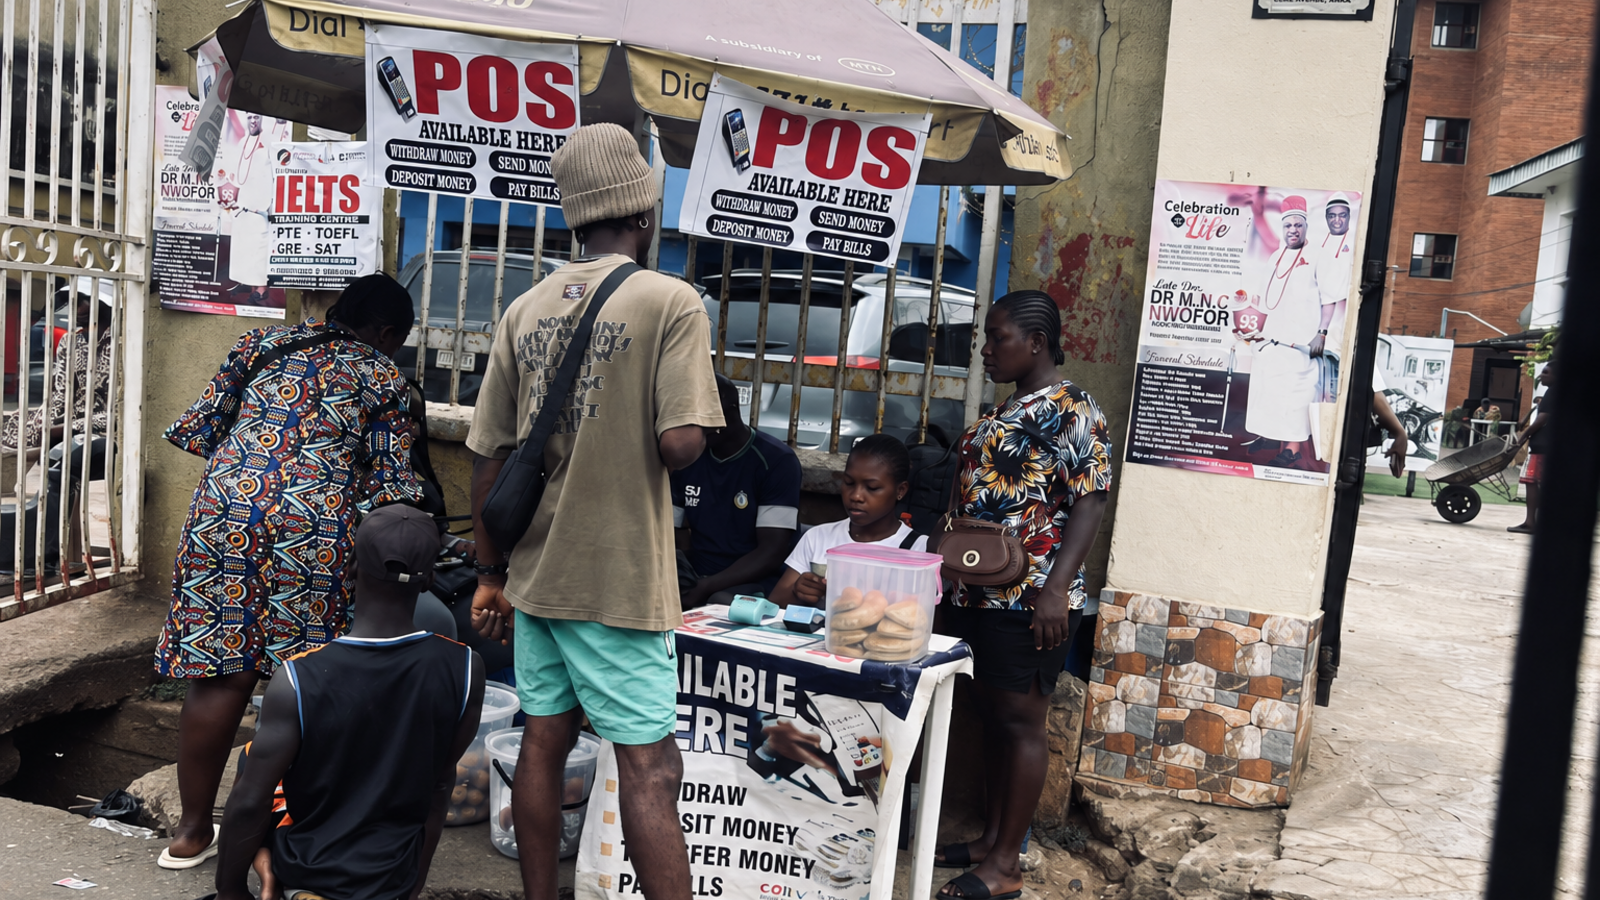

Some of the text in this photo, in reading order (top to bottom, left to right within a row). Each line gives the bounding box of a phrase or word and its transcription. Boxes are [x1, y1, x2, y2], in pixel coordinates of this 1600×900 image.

[289, 7, 346, 37] Dial
[705, 34, 717, 42] A
[720, 38, 801, 60] subsidiary
[806, 54, 823, 62] of
[412, 49, 576, 129] POS
[660, 68, 710, 101] Dia
[166, 100, 200, 111] Celebra
[419, 120, 567, 153] AVAILABLE HERE
[751, 105, 917, 190] POS
[389, 143, 472, 166] WITHDRAW MONEY
[498, 156, 551, 174] SEND MON
[161, 172, 177, 184] DR
[391, 169, 472, 191] DEPOSIT MONEY
[161, 184, 215, 199] NWOFOR
[275, 174, 360, 214] IELTS
[507, 182, 560, 200] PAY BILLS
[747, 172, 892, 213] AVAILABLE HERE
[715, 193, 795, 219] WITHDRAW MONEY
[1164, 200, 1240, 216] Celebration
[277, 227, 359, 239] PTE TOEFL
[712, 219, 790, 243] DEPOSIT MONEY
[818, 211, 885, 234] SEND MONEY
[1185, 214, 1231, 241] Life
[277, 243, 341, 255] GRE SAT
[822, 236, 872, 256] PAY BILLS
[1152, 279, 1178, 291] Late
[1150, 289, 1174, 305] DR
[1149, 304, 1229, 326] NWOFOR
[1239, 314, 1258, 331] 93
[675, 703, 749, 759] ERE
[680, 781, 747, 807] DRAW
[722, 816, 800, 846] MONEY
[739, 848, 816, 880] MONEY
[618, 873, 644, 895] PA
